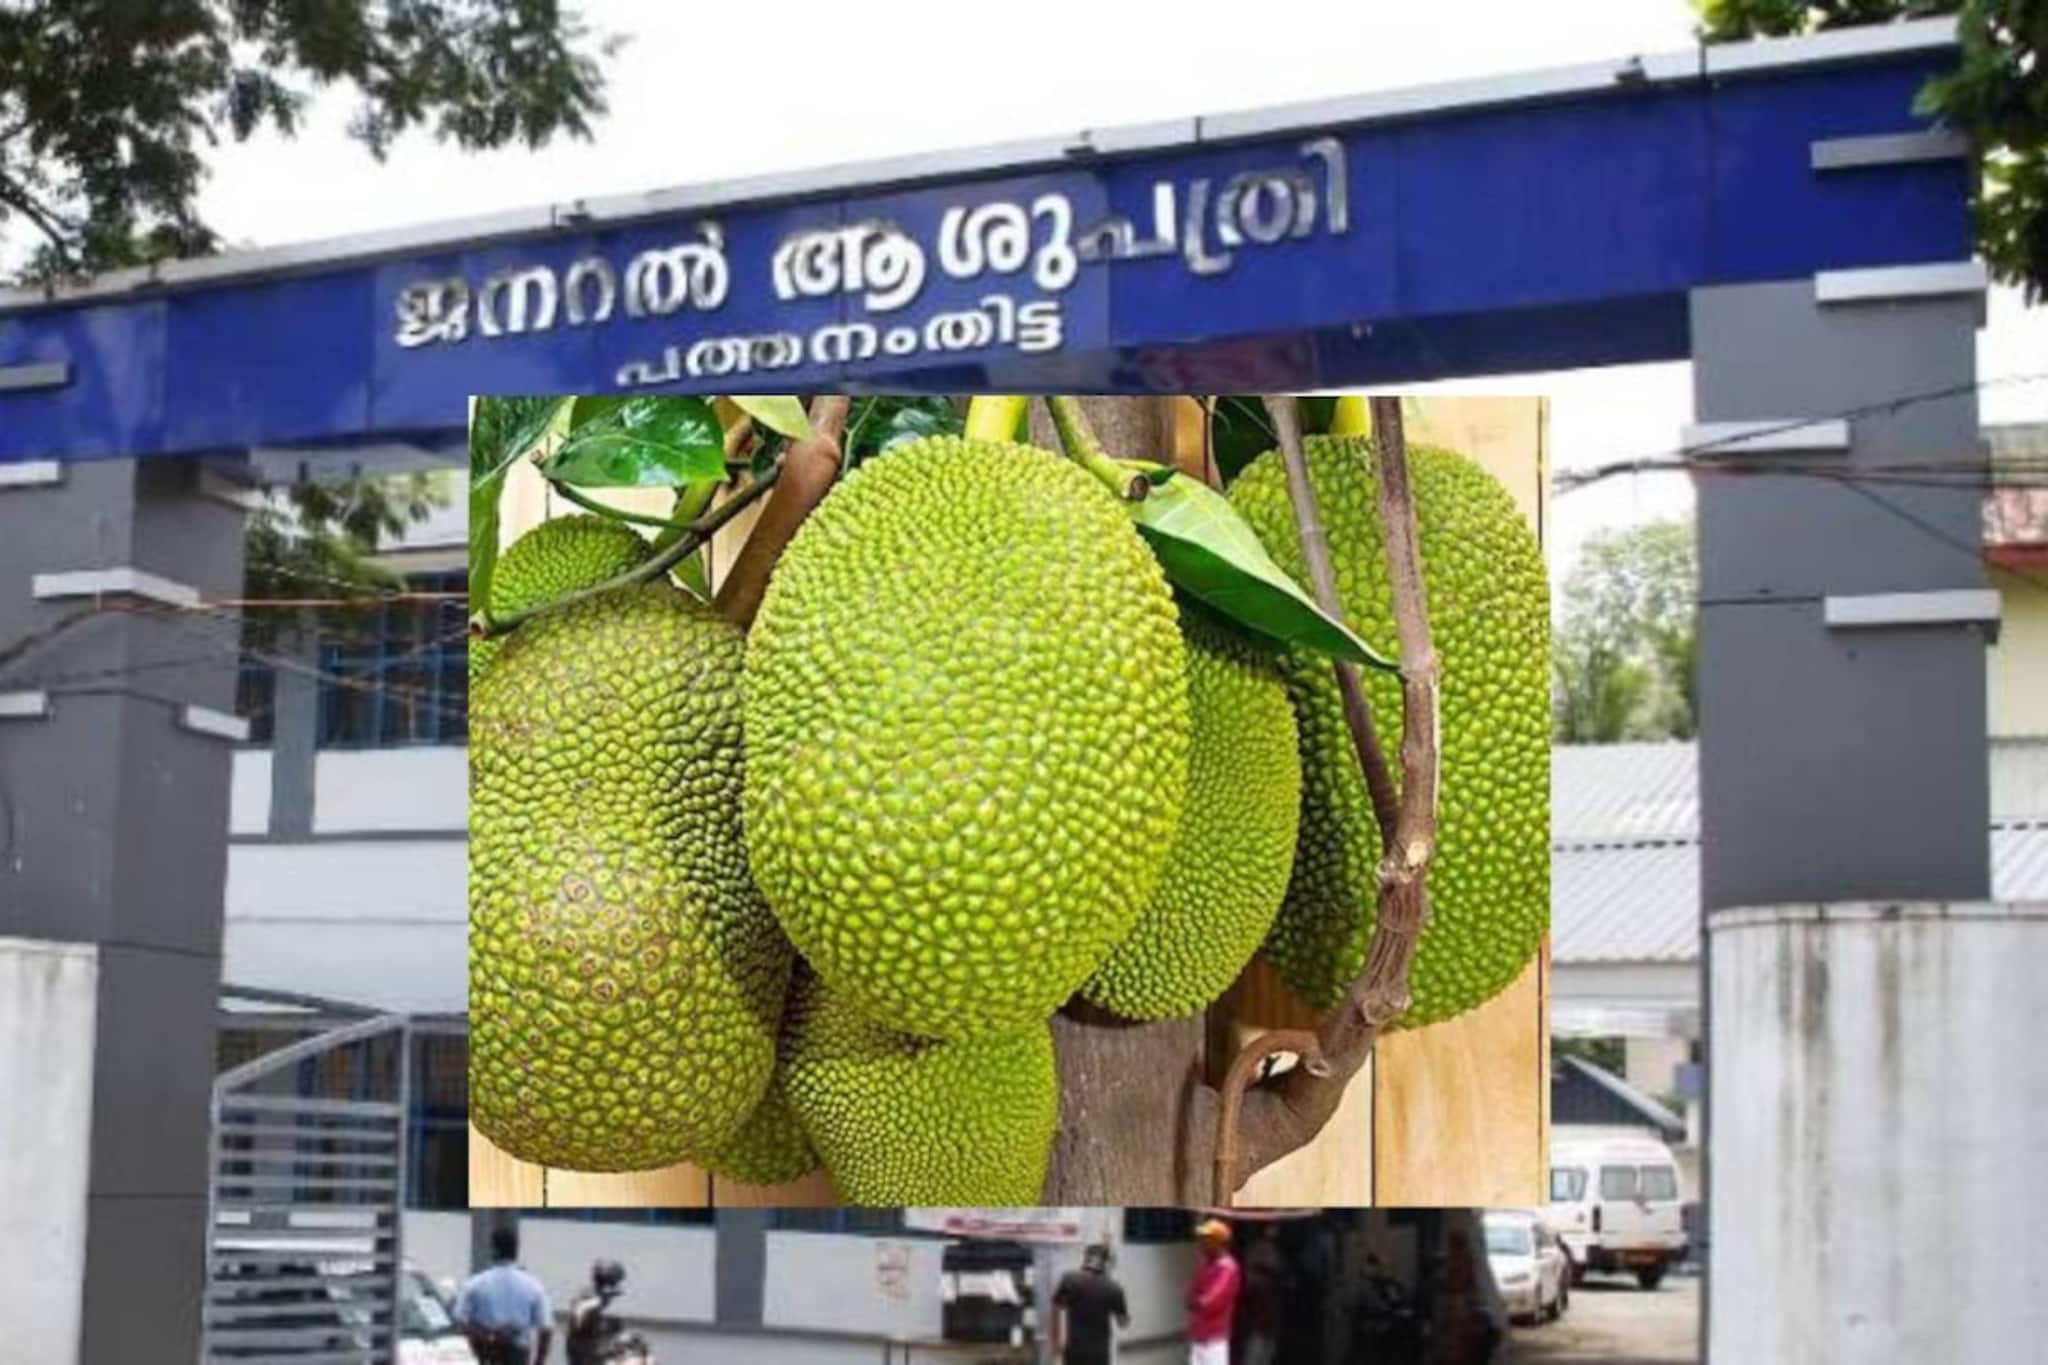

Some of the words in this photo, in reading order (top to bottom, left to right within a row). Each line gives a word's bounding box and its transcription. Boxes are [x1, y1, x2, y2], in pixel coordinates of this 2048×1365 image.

[397, 223, 728, 349] ജനറൽ
[774, 138, 1348, 310] ആശുപത്രി
[616, 295, 1064, 387] പത്തനംതിട്ട
